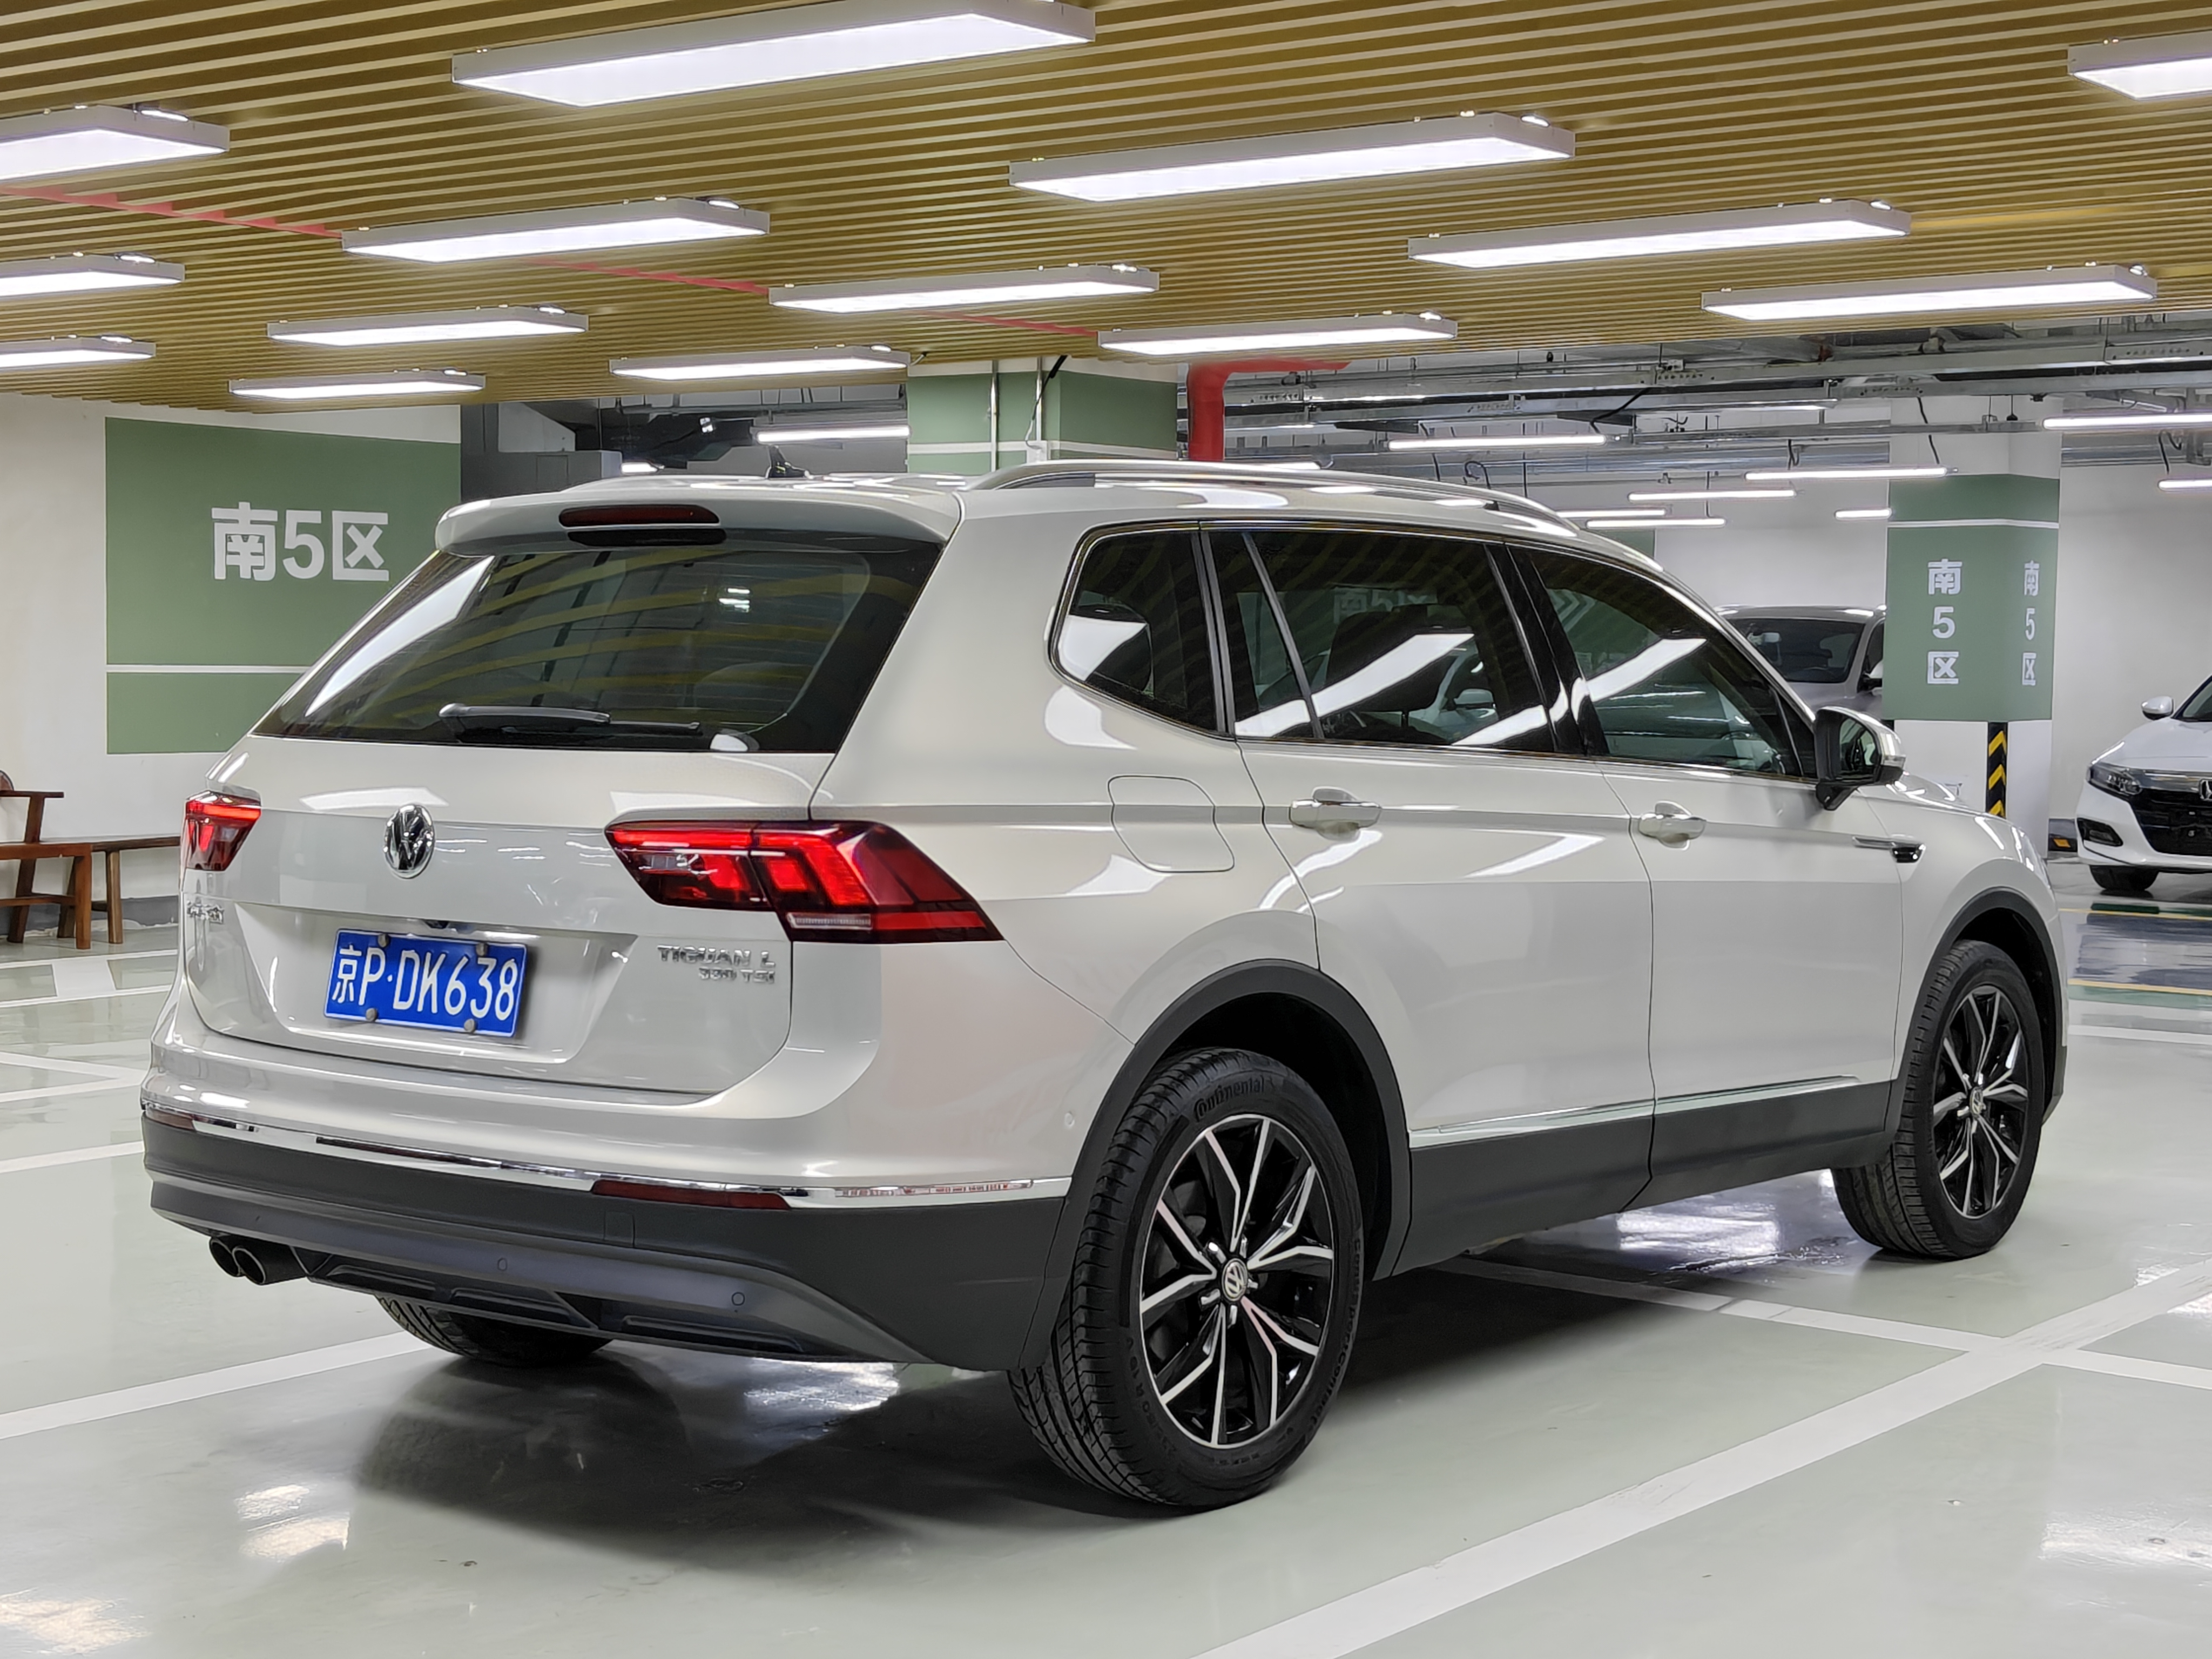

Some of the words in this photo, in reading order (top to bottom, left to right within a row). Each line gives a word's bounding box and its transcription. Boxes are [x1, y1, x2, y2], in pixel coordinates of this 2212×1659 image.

[211, 502, 389, 581] 南5区
[1927, 558, 1963, 684] 南5区
[2021, 559, 2040, 686] 南5区
[657, 945, 751, 966] TIGUAN
[760, 951, 776, 967] L
[1193, 1075, 1265, 1122] Continental
